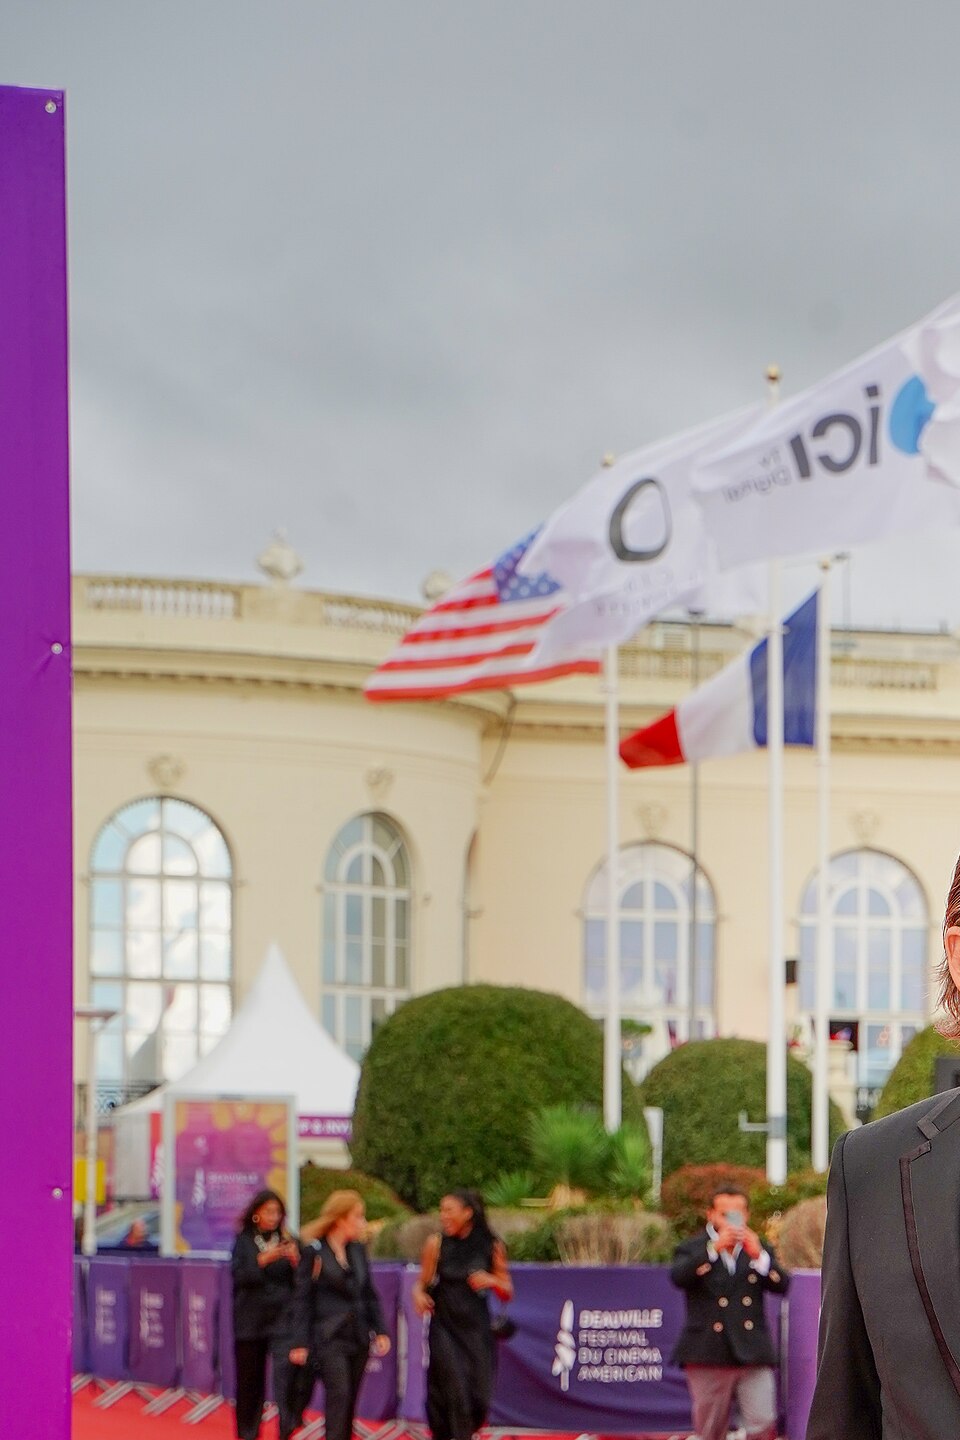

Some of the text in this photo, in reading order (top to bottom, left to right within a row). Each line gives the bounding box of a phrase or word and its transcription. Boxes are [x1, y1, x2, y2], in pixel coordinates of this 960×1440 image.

[579, 1309, 663, 1330] DEAUVILLE
[578, 1329, 650, 1348] FESTIVAL
[578, 1346, 663, 1366] DU CINEMA
[577, 1364, 663, 1383] AMERICAIN
